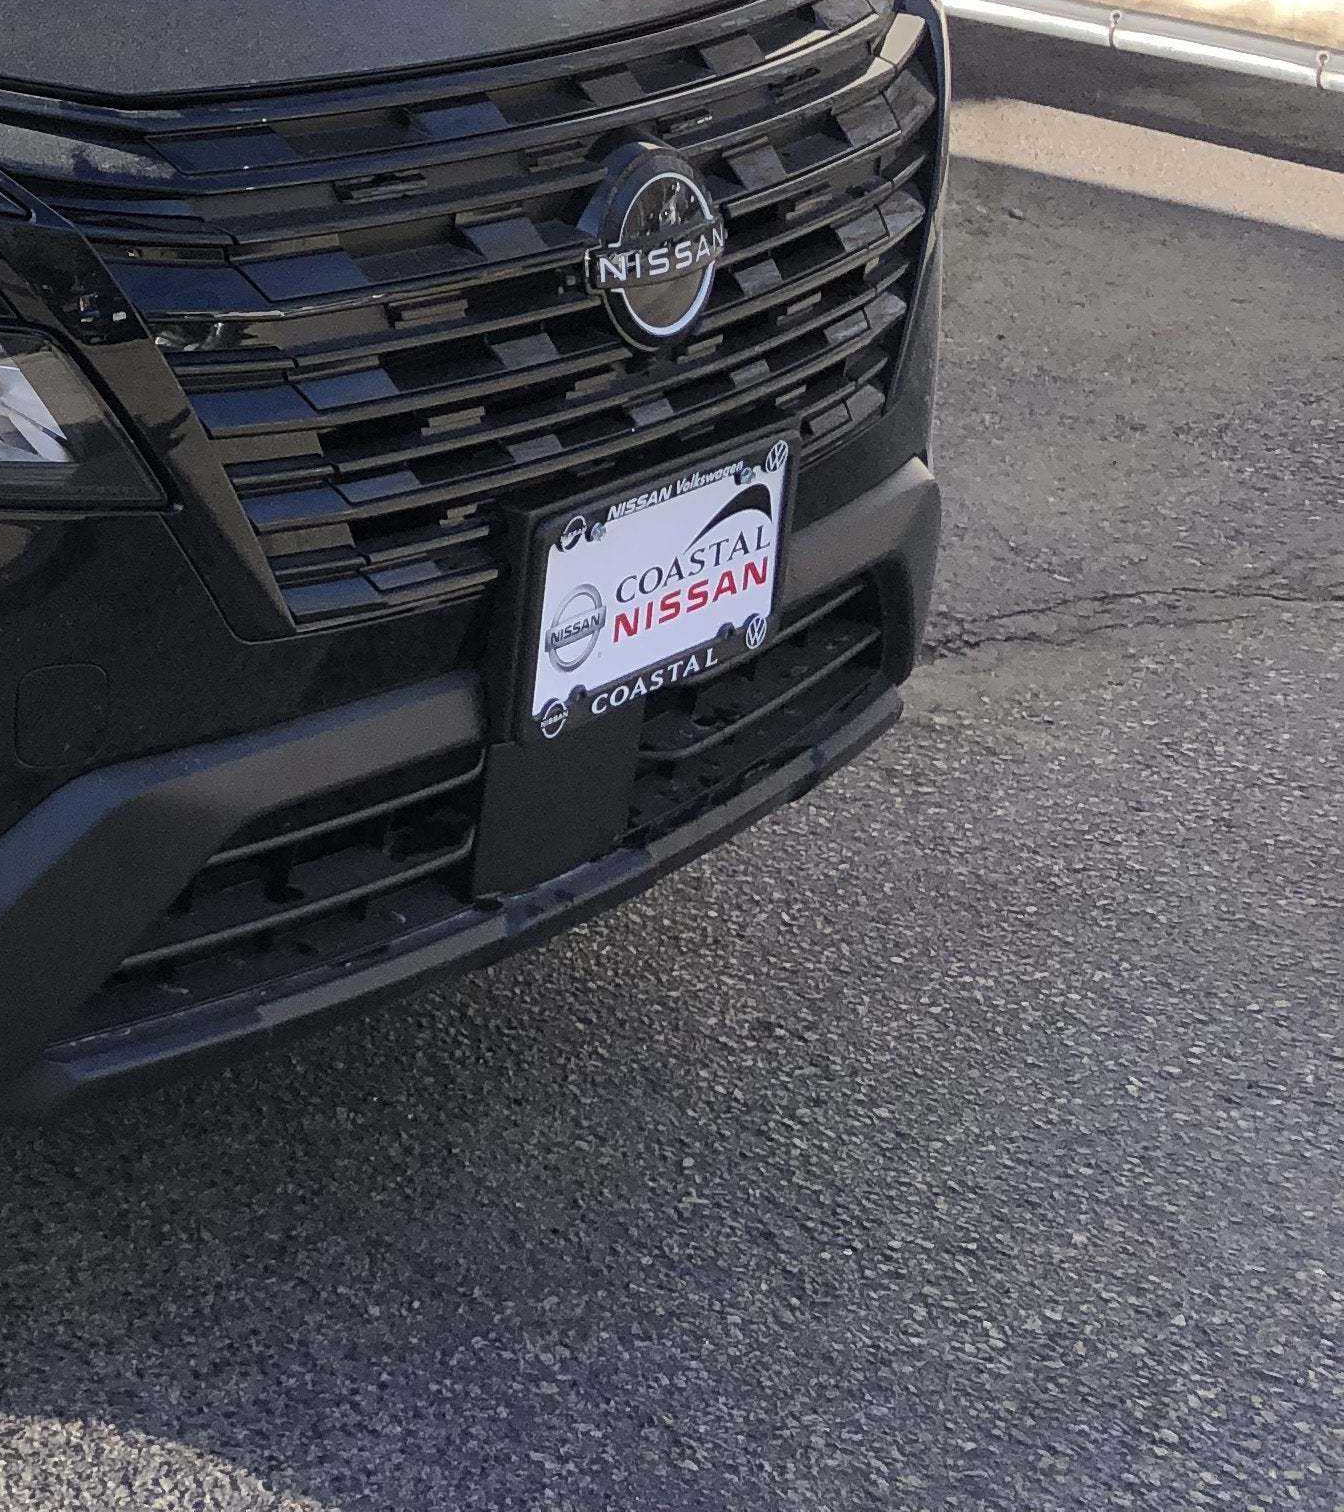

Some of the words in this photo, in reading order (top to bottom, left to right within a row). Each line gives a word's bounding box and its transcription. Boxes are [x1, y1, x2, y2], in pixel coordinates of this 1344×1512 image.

[598, 227, 724, 283] NISSAN
[607, 485, 673, 521] NISSAN
[676, 461, 744, 495] Volkswagen
[615, 524, 771, 604] COASTAL
[550, 612, 601, 645] NISSAN
[613, 556, 769, 643] NISSAN
[591, 647, 719, 715] COASTAL
